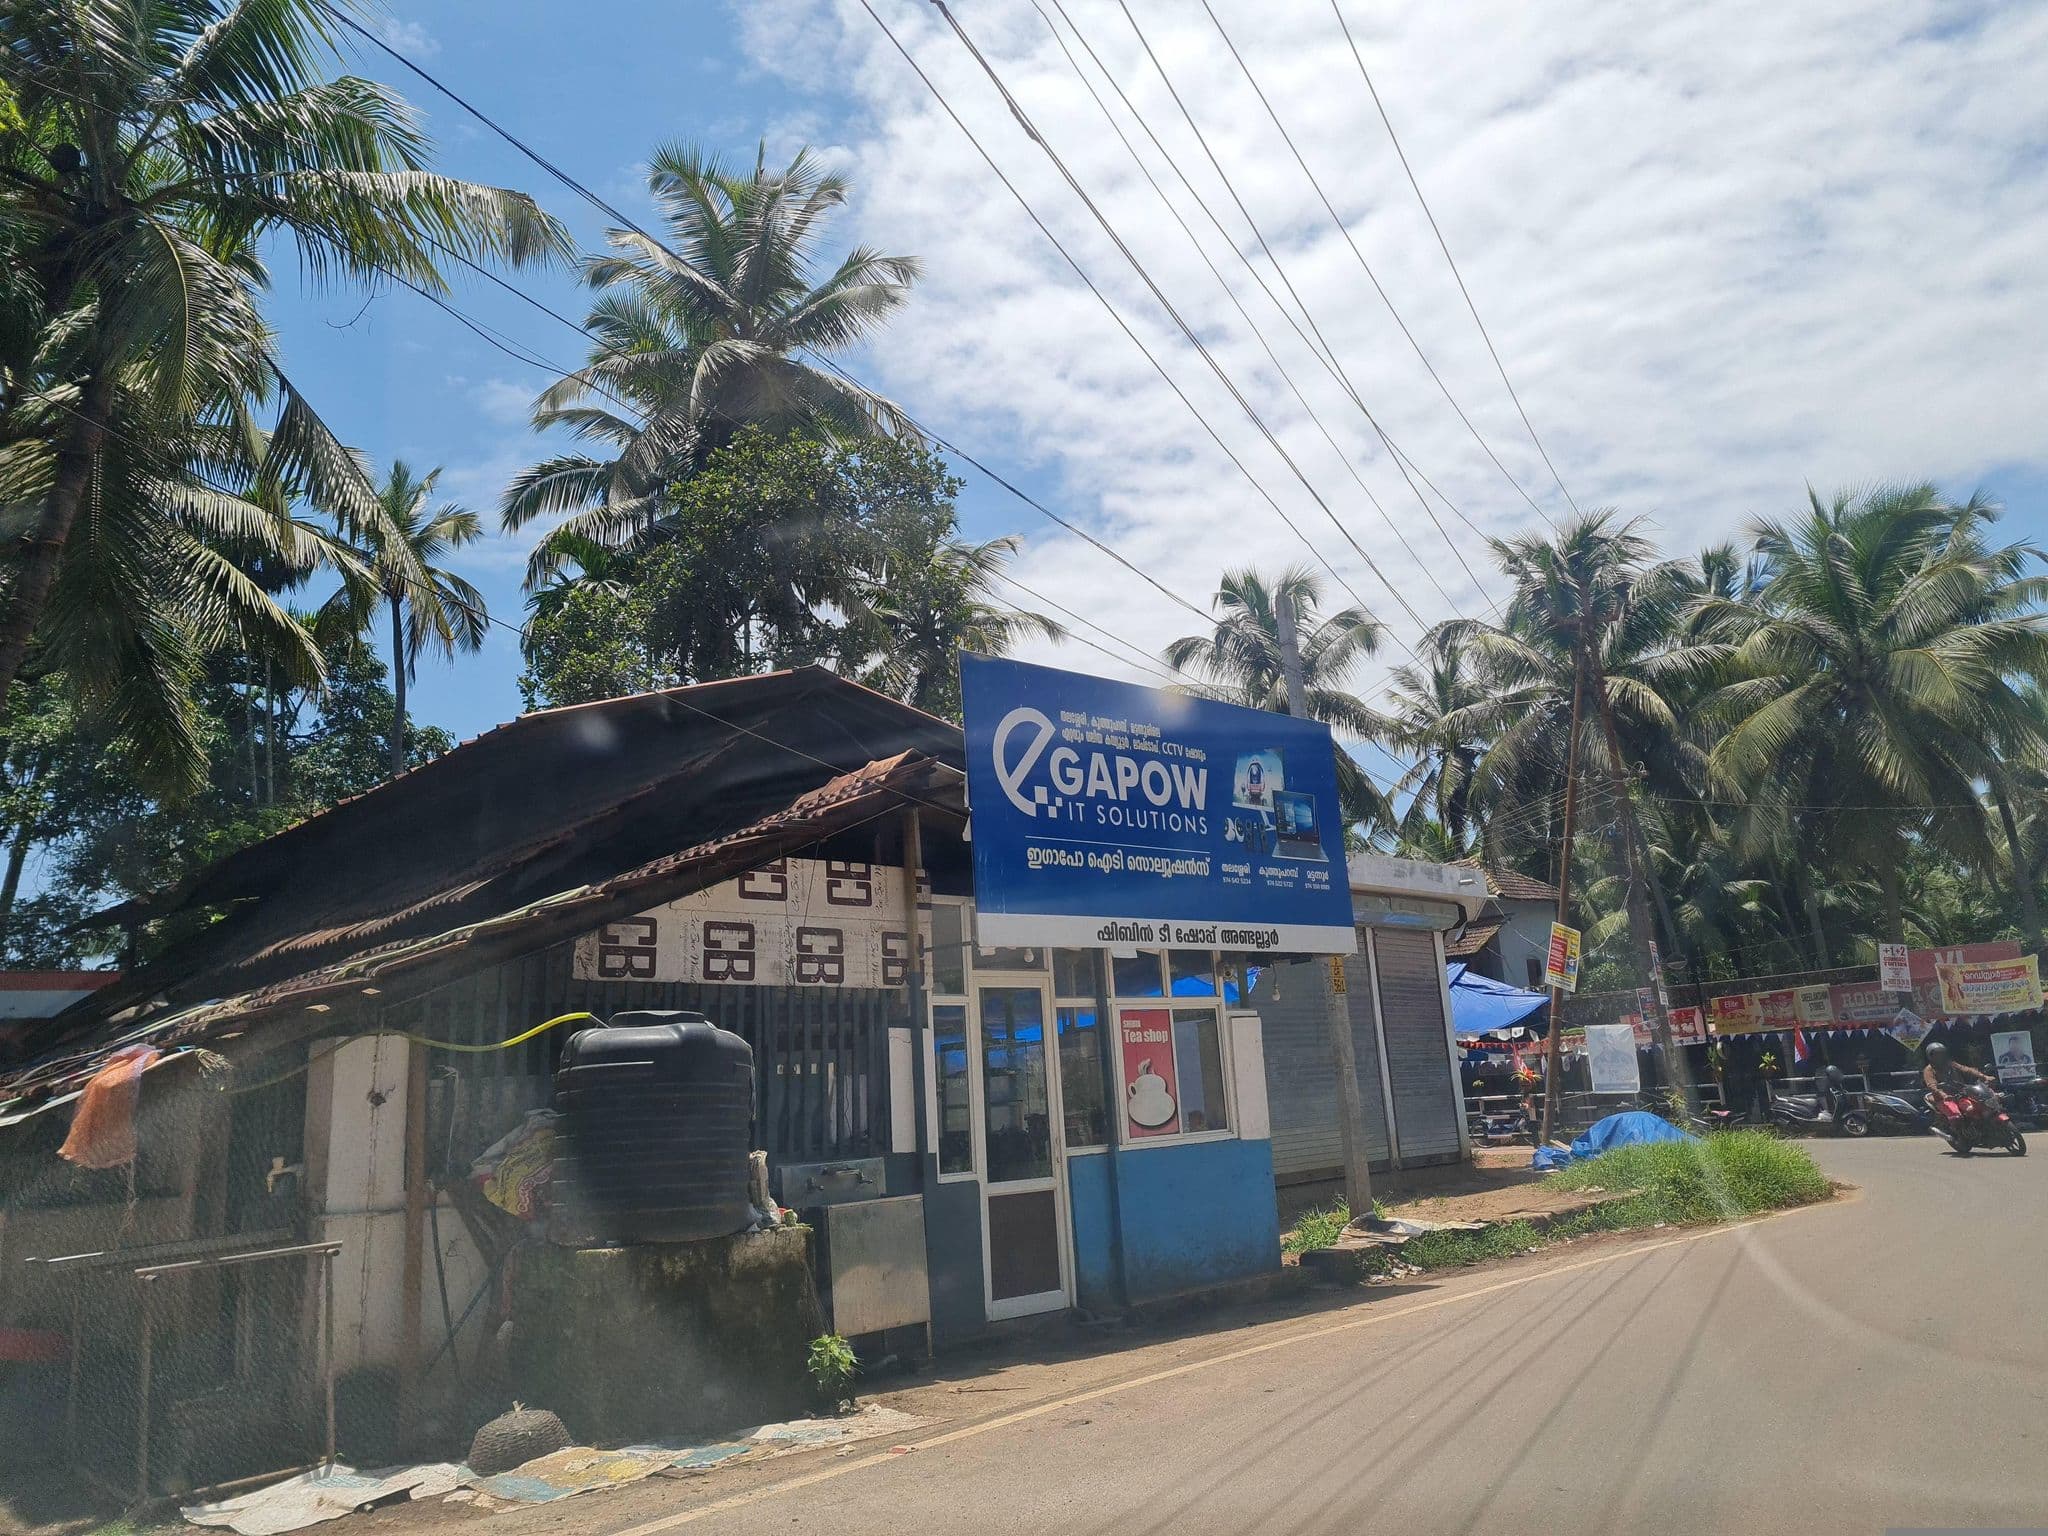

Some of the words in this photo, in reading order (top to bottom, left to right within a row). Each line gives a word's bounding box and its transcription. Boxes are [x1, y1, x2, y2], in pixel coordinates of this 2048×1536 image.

[1162, 742, 1184, 757] CCTV
[1068, 801, 1085, 822] IT
[1096, 804, 1208, 835] SOLUTIONS
[1026, 846, 1084, 869] ഇഗാപോ
[1087, 849, 1125, 873] ഐടി
[1097, 921, 1154, 942] ഷിബിൻ
[1159, 923, 1171, 943] ടീ
[1175, 925, 1217, 944] ഷോപ്പ്
[1221, 928, 1280, 949] അണ്ടല്ലൂർ
[703, 920, 756, 981] CB
[795, 926, 845, 984] CB
[1123, 1029, 1142, 1043] Tea
[1144, 1028, 1168, 1044] shop
